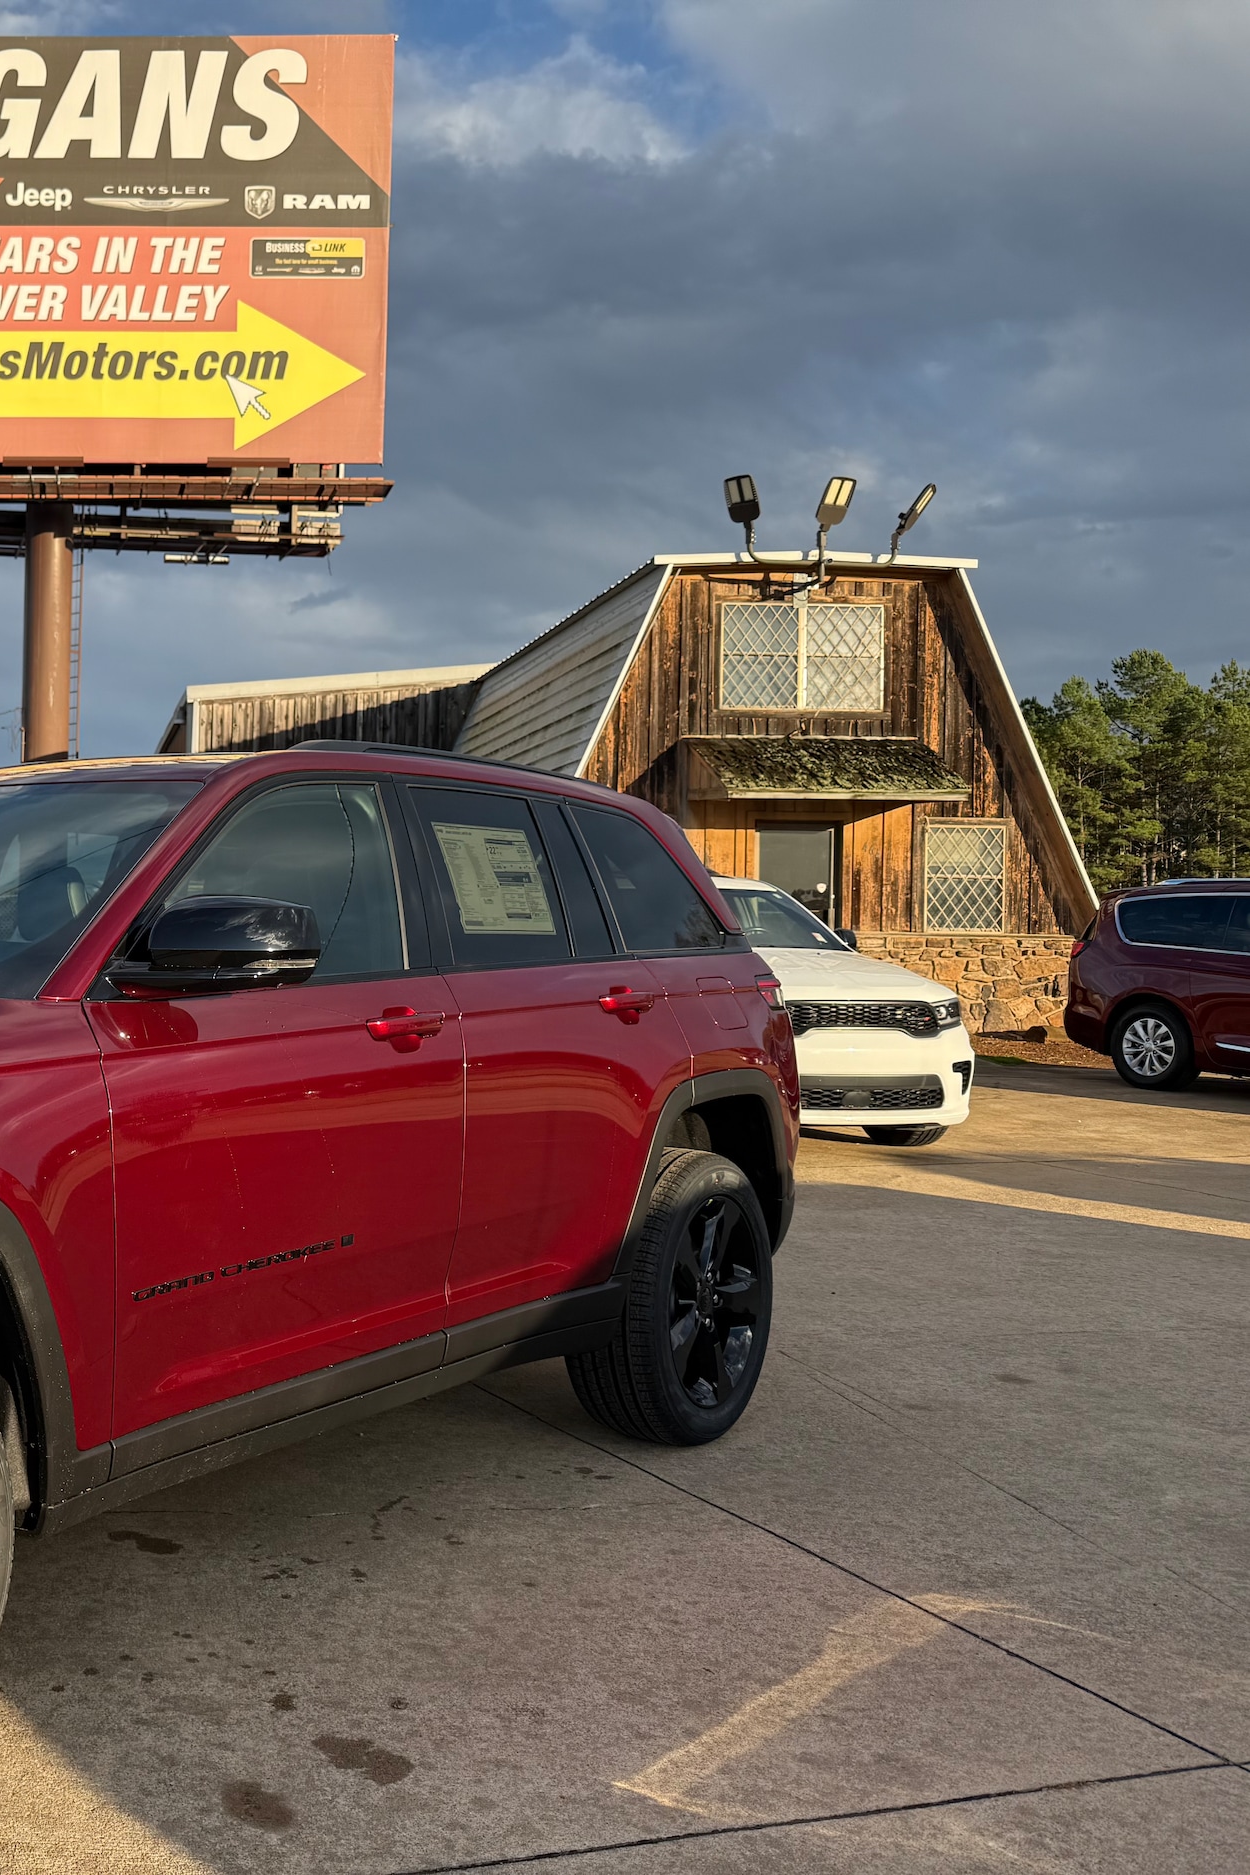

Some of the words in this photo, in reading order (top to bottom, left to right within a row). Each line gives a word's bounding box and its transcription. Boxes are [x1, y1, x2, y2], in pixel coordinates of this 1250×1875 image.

[5, 182, 72, 211] Jeep
[102, 185, 211, 195] CHRYSLER
[282, 194, 370, 209] RAM
[91, 237, 139, 274] IN
[150, 237, 226, 274] THE
[324, 243, 347, 252] LINK
[81, 285, 230, 322] VALLEY
[132, 1271, 215, 1302] GRAND
[220, 1239, 336, 1278] CHEROKEE
